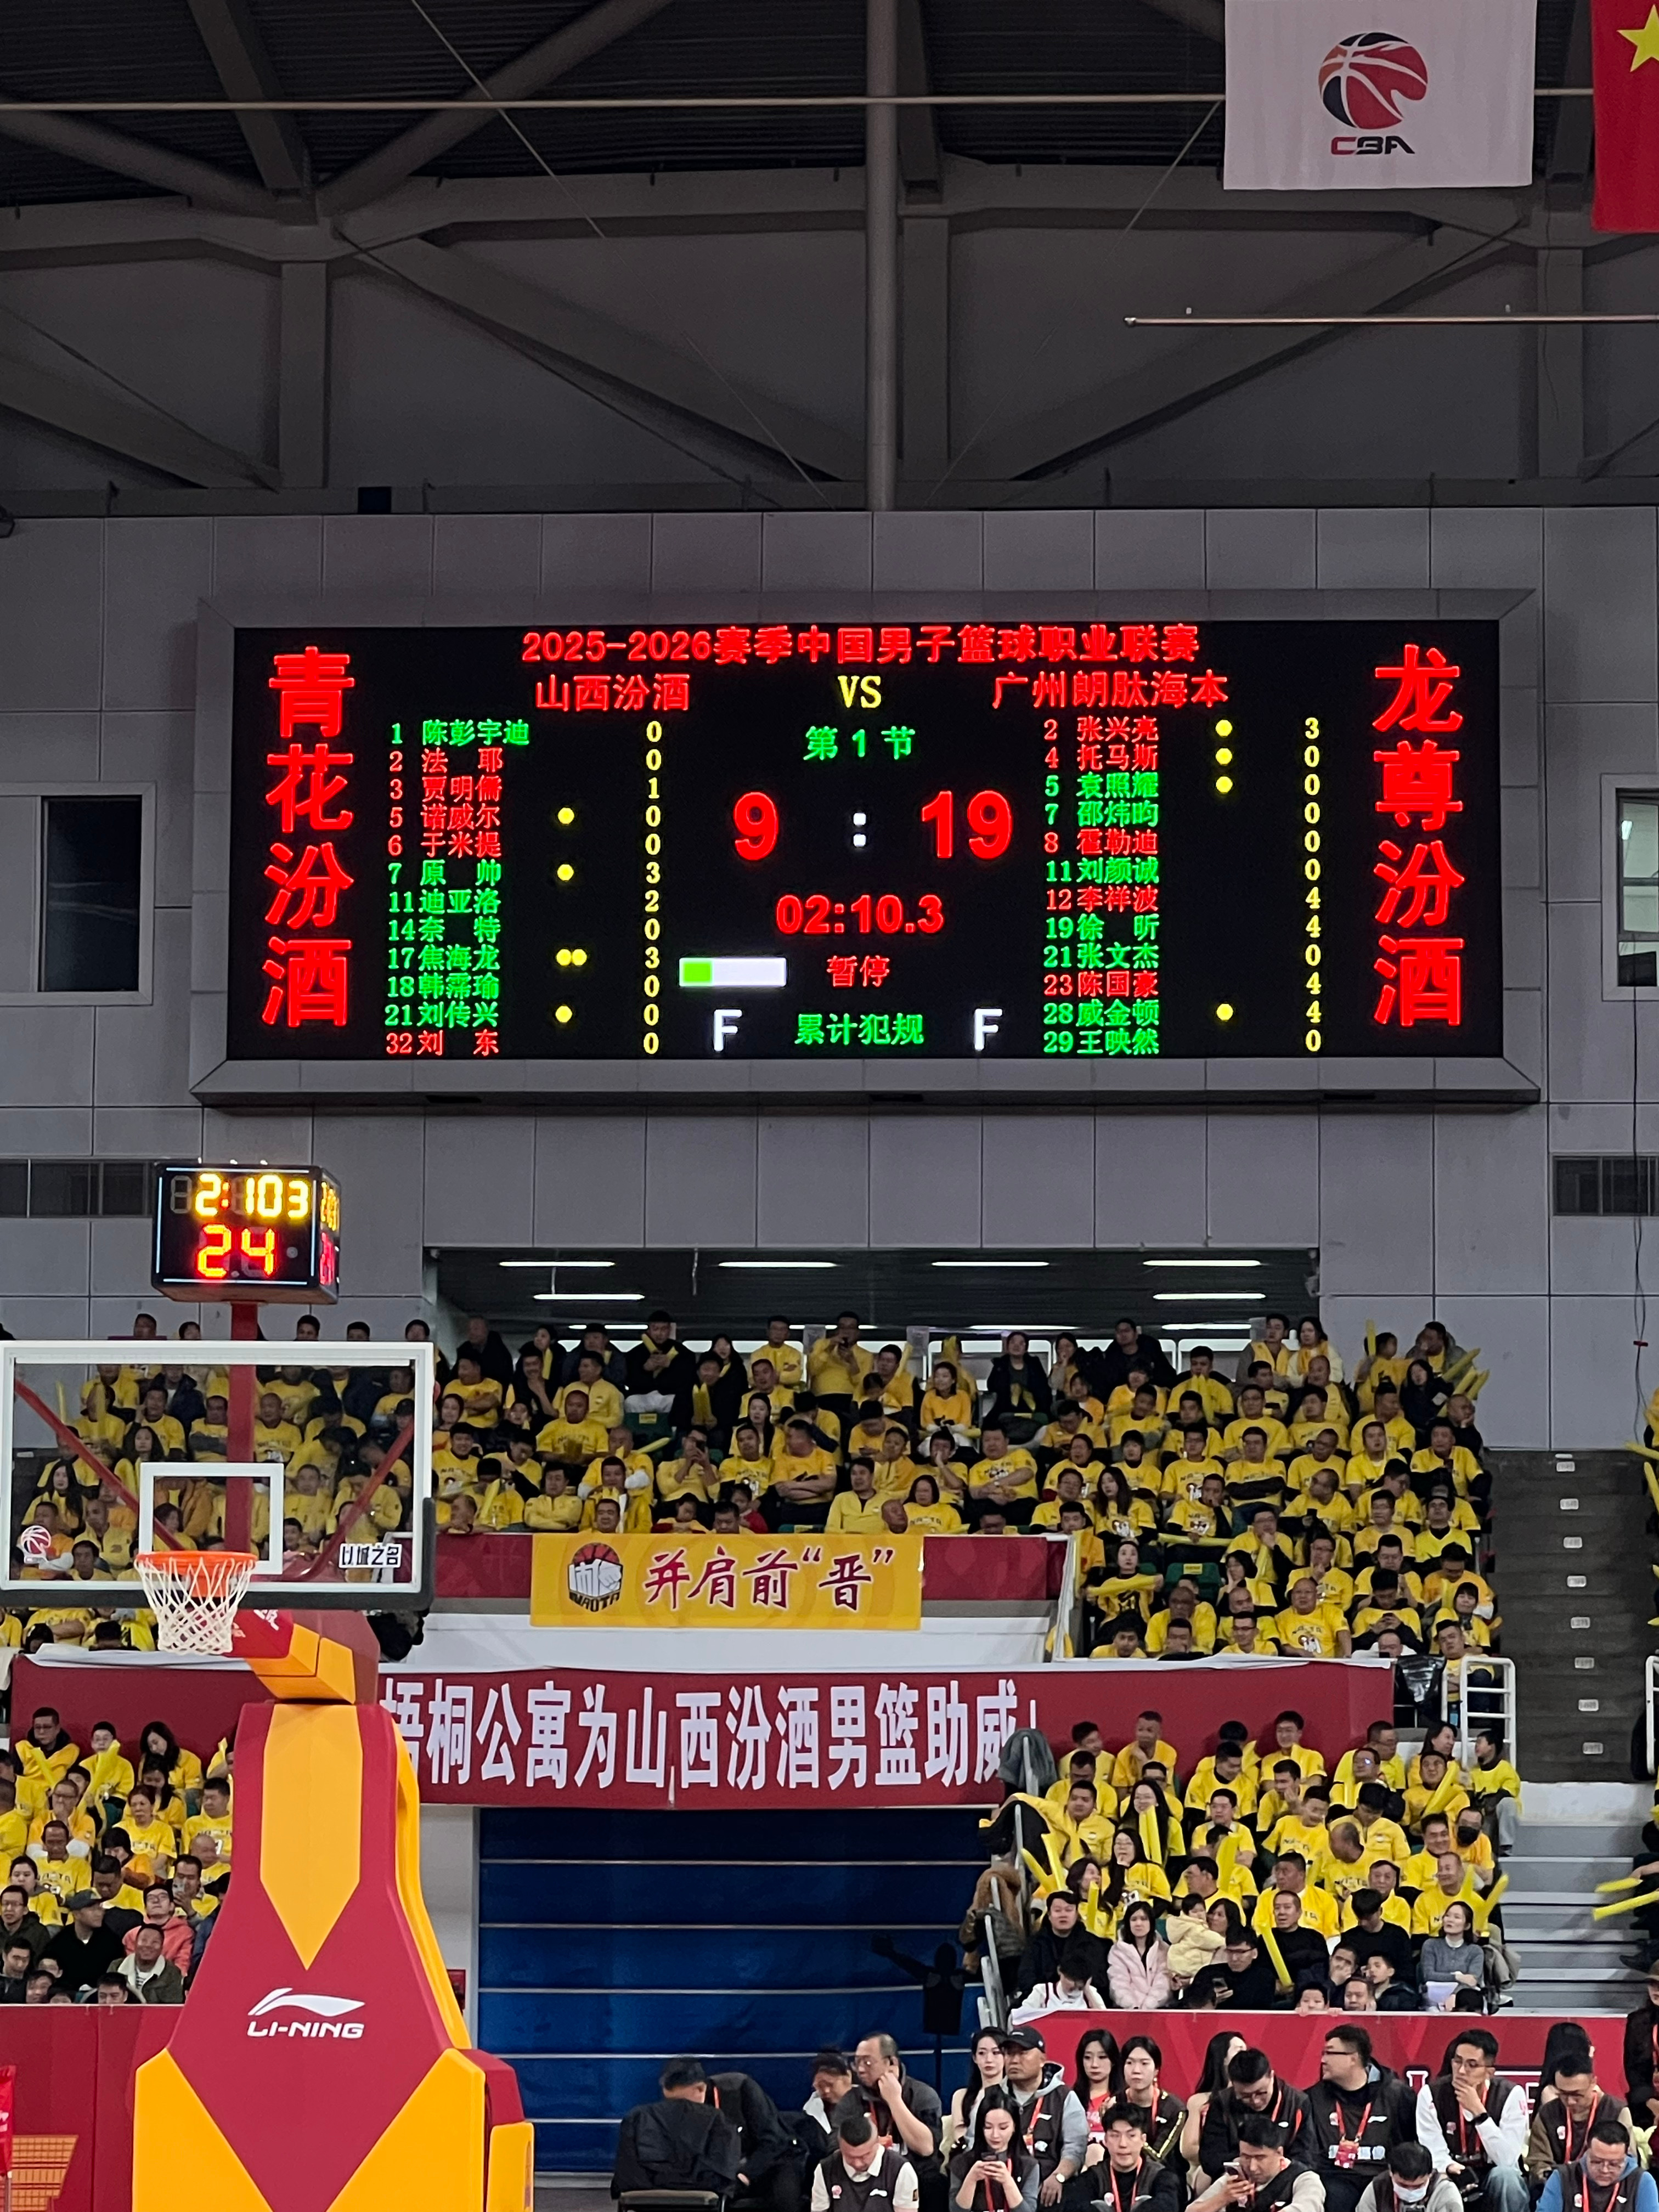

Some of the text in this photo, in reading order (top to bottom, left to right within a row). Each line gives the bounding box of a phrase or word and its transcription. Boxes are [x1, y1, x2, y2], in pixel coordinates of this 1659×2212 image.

[1331, 136, 1415, 155] CBA
[522, 625, 1199, 664] 2025-2026赛季中国男子篮球职业联赛
[535, 673, 690, 712] 山西汾酒
[837, 675, 882, 708] VS
[992, 669, 1229, 709] 广州朗肽海本
[392, 719, 662, 746] 1 陈彭宇迪 0
[1043, 715, 1319, 743] 2 张兴亮 3
[389, 751, 403, 772] 2
[646, 749, 662, 771] 0
[1045, 744, 1320, 771] 4 托马斯 0
[390, 775, 660, 802] 3 贾明儒 1
[1045, 775, 1059, 797] 5
[1304, 774, 1321, 795] 0
[389, 803, 661, 830] 5 诺威尔 0
[733, 792, 779, 861] 9
[921, 790, 1013, 860] 19
[1045, 803, 1059, 825] 7
[1304, 802, 1321, 824] 0
[263, 646, 354, 1026] 青花汾酒
[387, 831, 661, 857] 6 于米提 0
[1043, 831, 1059, 854] 8
[1304, 830, 1321, 853] 0
[1373, 644, 1464, 1026] 龙尊汾酒
[388, 862, 402, 884] 7
[646, 861, 661, 884] 3
[1046, 857, 1321, 883] 11 刘颜诚 0
[388, 888, 659, 914] 11 迪亚洛 2
[1046, 885, 1321, 912] 12 李祥波 4
[776, 894, 945, 934] 02:10.3
[1046, 916, 1074, 939] 19
[1305, 915, 1322, 938] 4
[388, 918, 416, 941] 14
[644, 918, 660, 940] 0
[388, 944, 660, 970] 17 焦海龙 3
[1043, 942, 1321, 968] 21 张文杰 0
[826, 955, 890, 988] 暂停
[1043, 970, 1322, 997] 23 陈国豪 4
[387, 975, 415, 998] 18
[644, 974, 660, 998] 0
[385, 1001, 659, 1028] 21 刘传兴 0
[1043, 999, 1322, 1026] 28 威金顿 4
[713, 1009, 743, 1052] F
[794, 1012, 924, 1046] 累计犯规
[974, 1008, 1003, 1052] F
[1043, 1028, 1321, 1054] 29 王映然 0
[386, 1032, 413, 1054] 32
[643, 1032, 659, 1054] 0
[197, 1224, 275, 1278] 24
[247, 2021, 365, 2039] LI-NING
